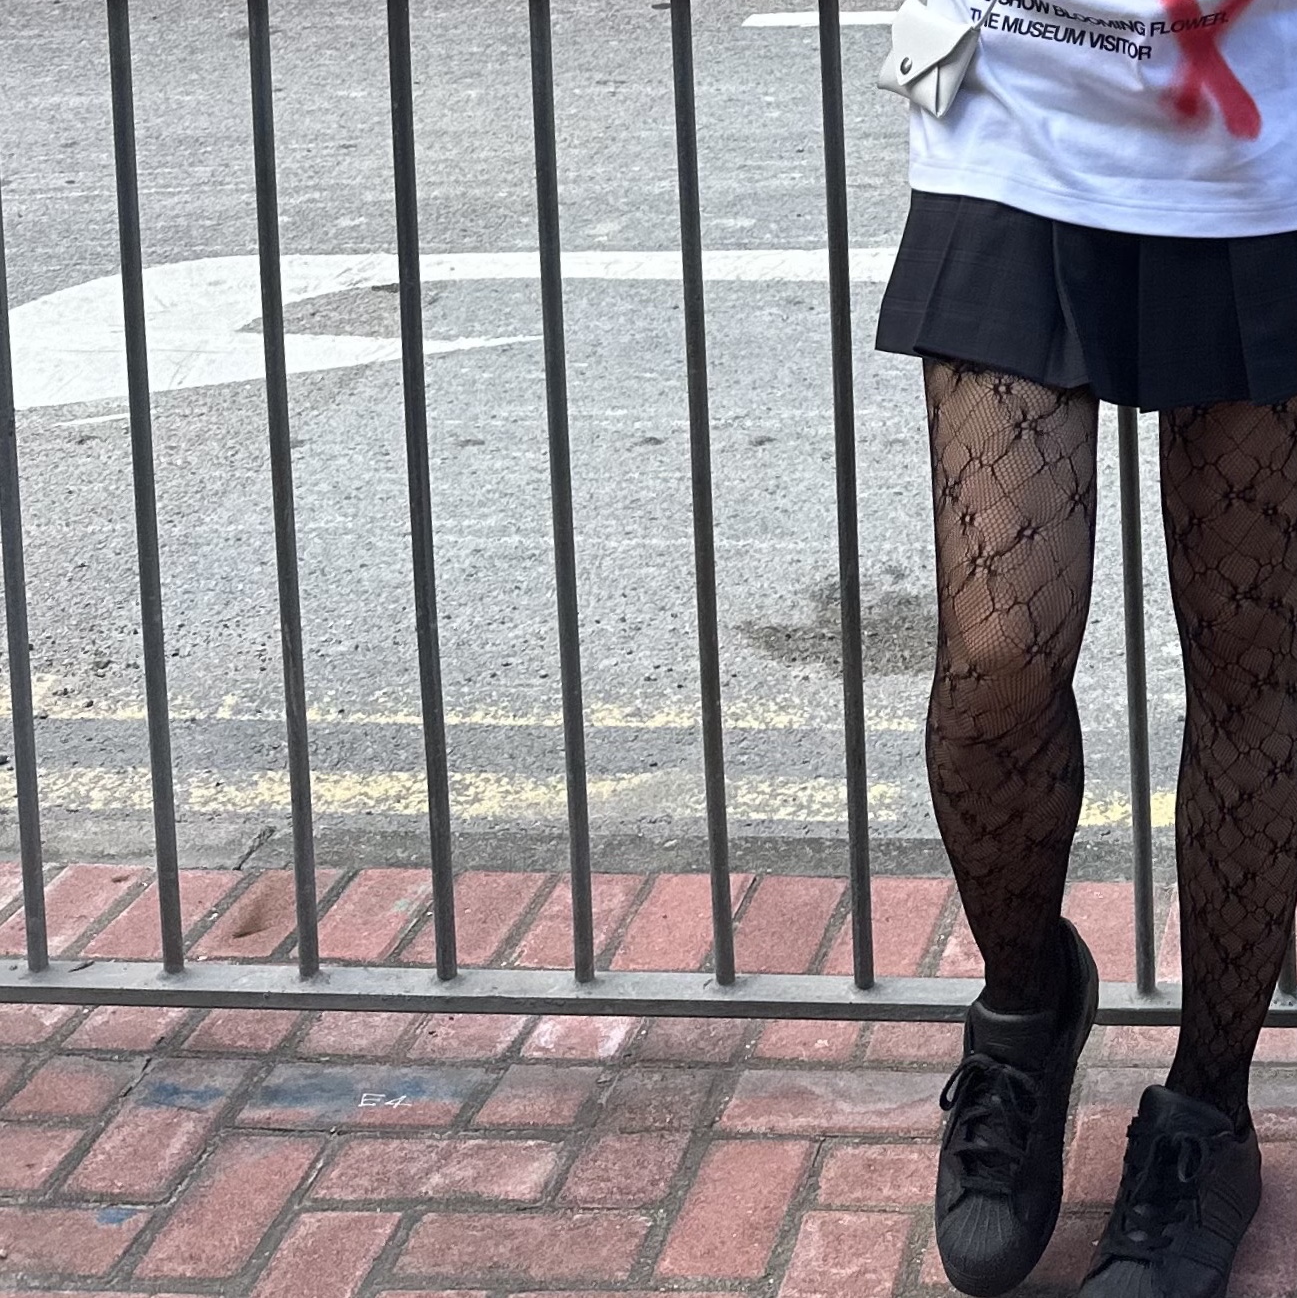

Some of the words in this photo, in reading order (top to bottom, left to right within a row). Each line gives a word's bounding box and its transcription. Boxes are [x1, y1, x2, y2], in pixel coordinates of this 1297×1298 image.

[1001, 15, 1087, 46] MUSEUM
[1089, 31, 1152, 61] VISITOR
[1053, 4, 1146, 36] BLOOMING
